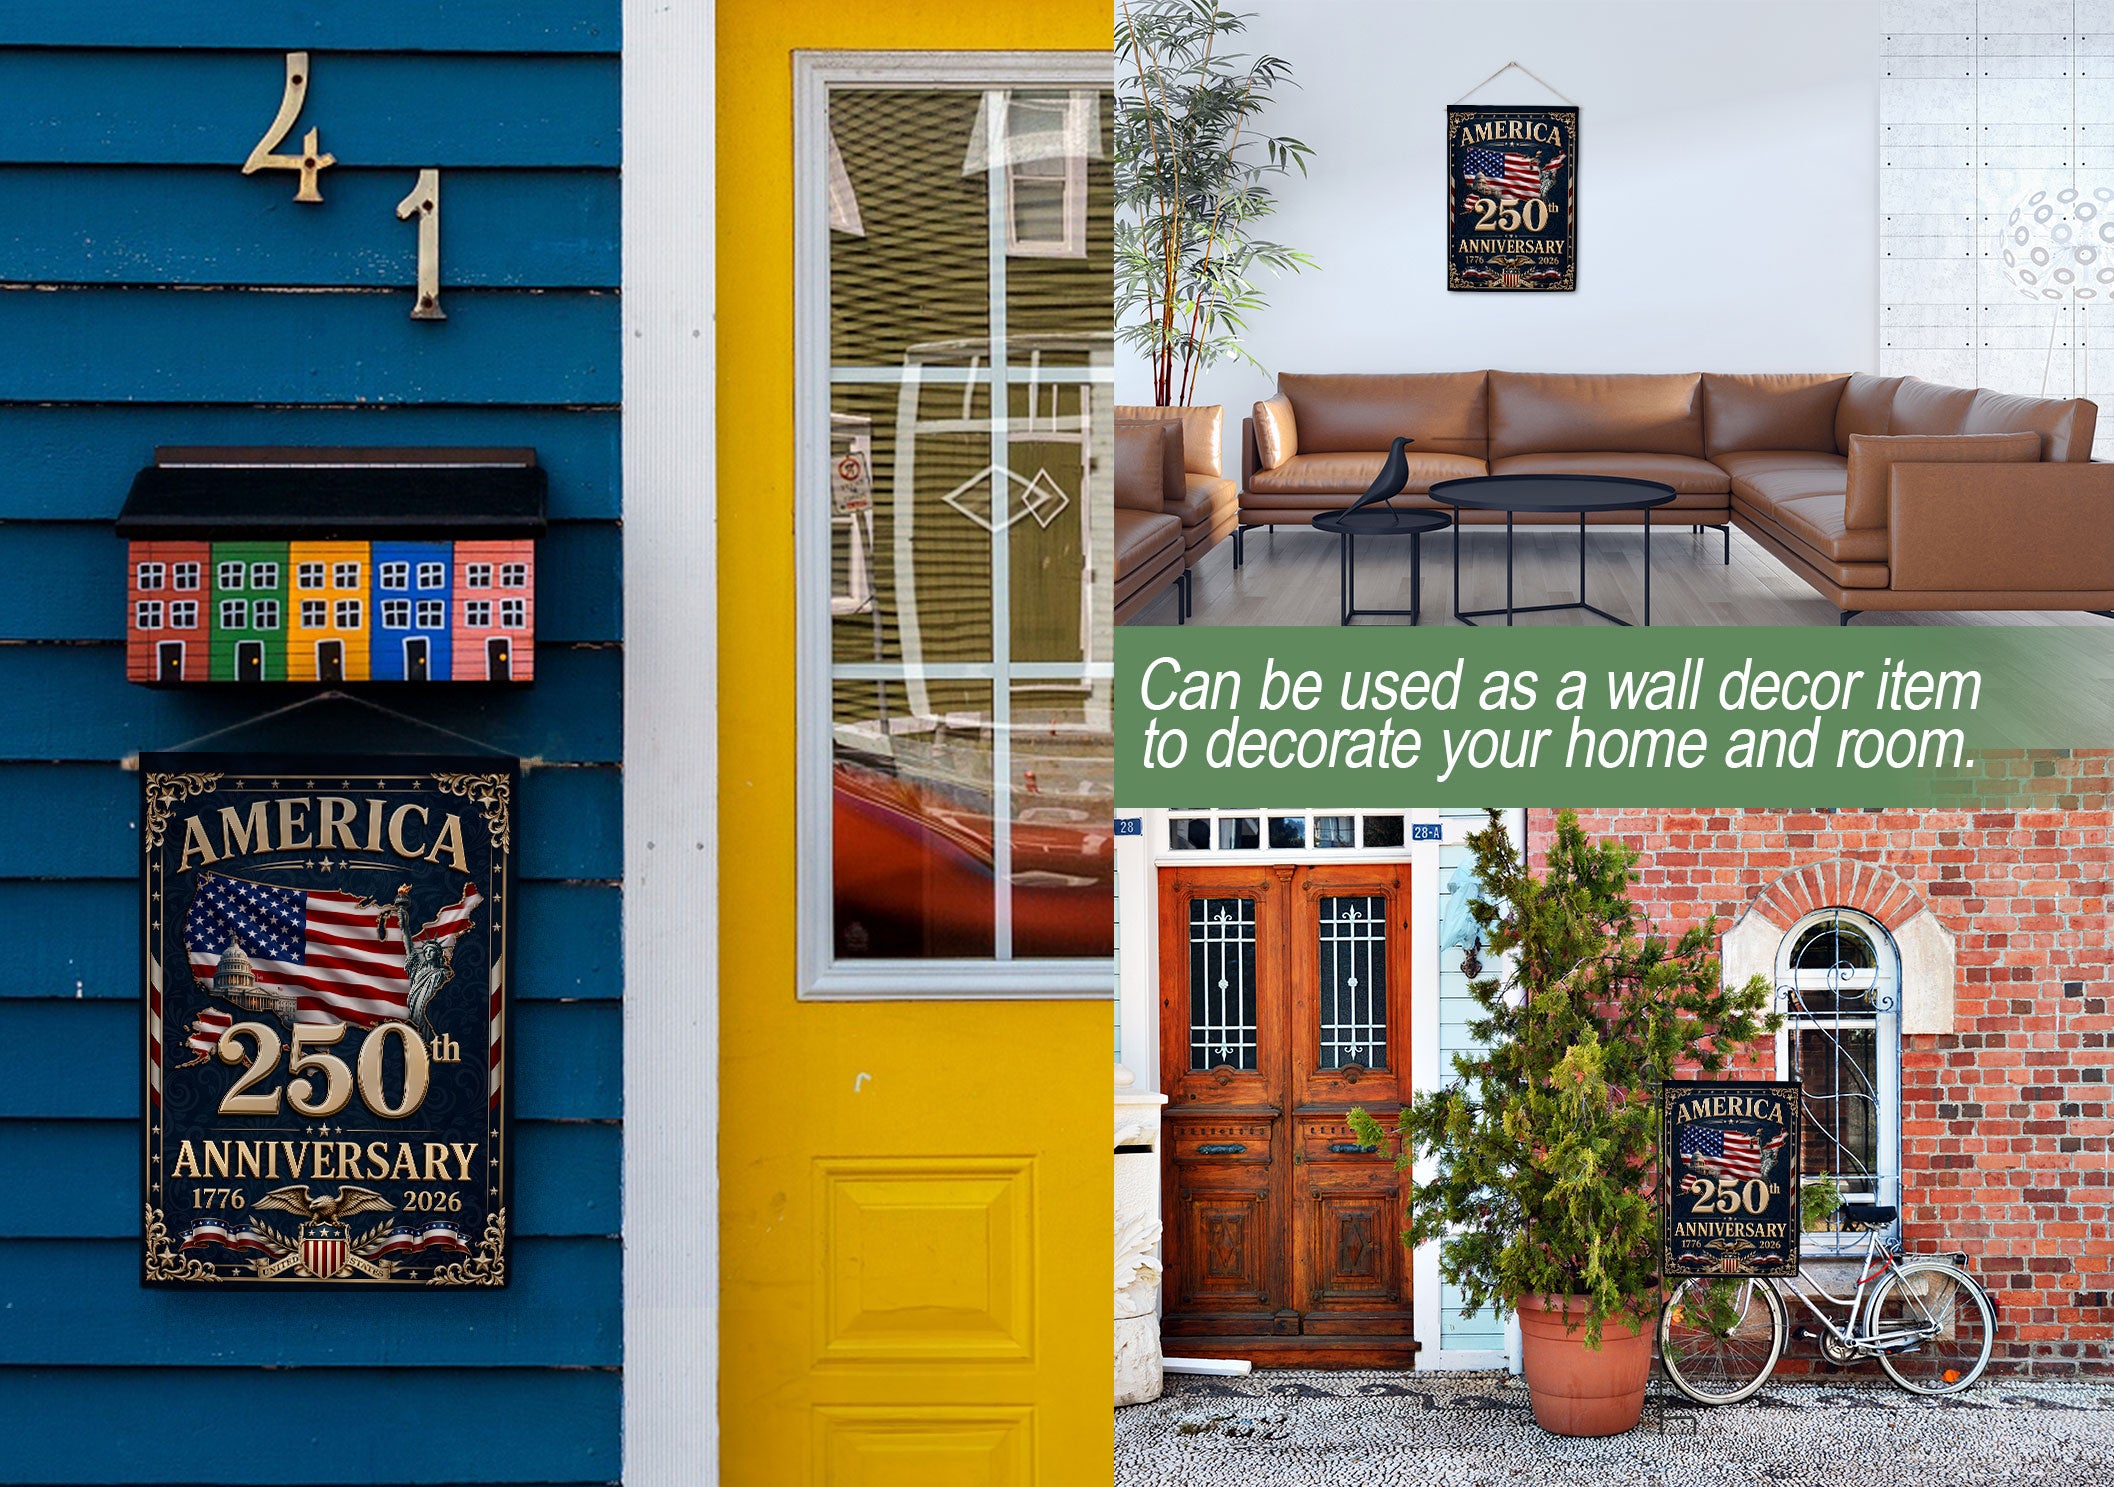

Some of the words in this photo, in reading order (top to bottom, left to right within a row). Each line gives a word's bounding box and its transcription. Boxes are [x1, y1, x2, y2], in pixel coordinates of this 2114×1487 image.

[1460, 120, 1562, 147] AMERICA
[1459, 239, 1565, 254] ANNIVERSARY
[1465, 255, 1484, 264] 1776
[1538, 257, 1559, 265] 2026
[177, 795, 470, 875] AMERICA
[1120, 821, 1134, 833] 28
[1414, 826, 1440, 839] 28-A
[1676, 1096, 1784, 1125] AMERICA
[171, 1139, 479, 1182] ANNIVERSARY
[192, 1188, 246, 1210] 1776
[402, 1190, 463, 1213] 2026
[1674, 1222, 1787, 1238] ANNIVERSARY
[1681, 1240, 1702, 1248] 1776
[1759, 1241, 1781, 1249] 2026
[262, 1255, 300, 1277] UNITED
[349, 1257, 385, 1278] STATES
